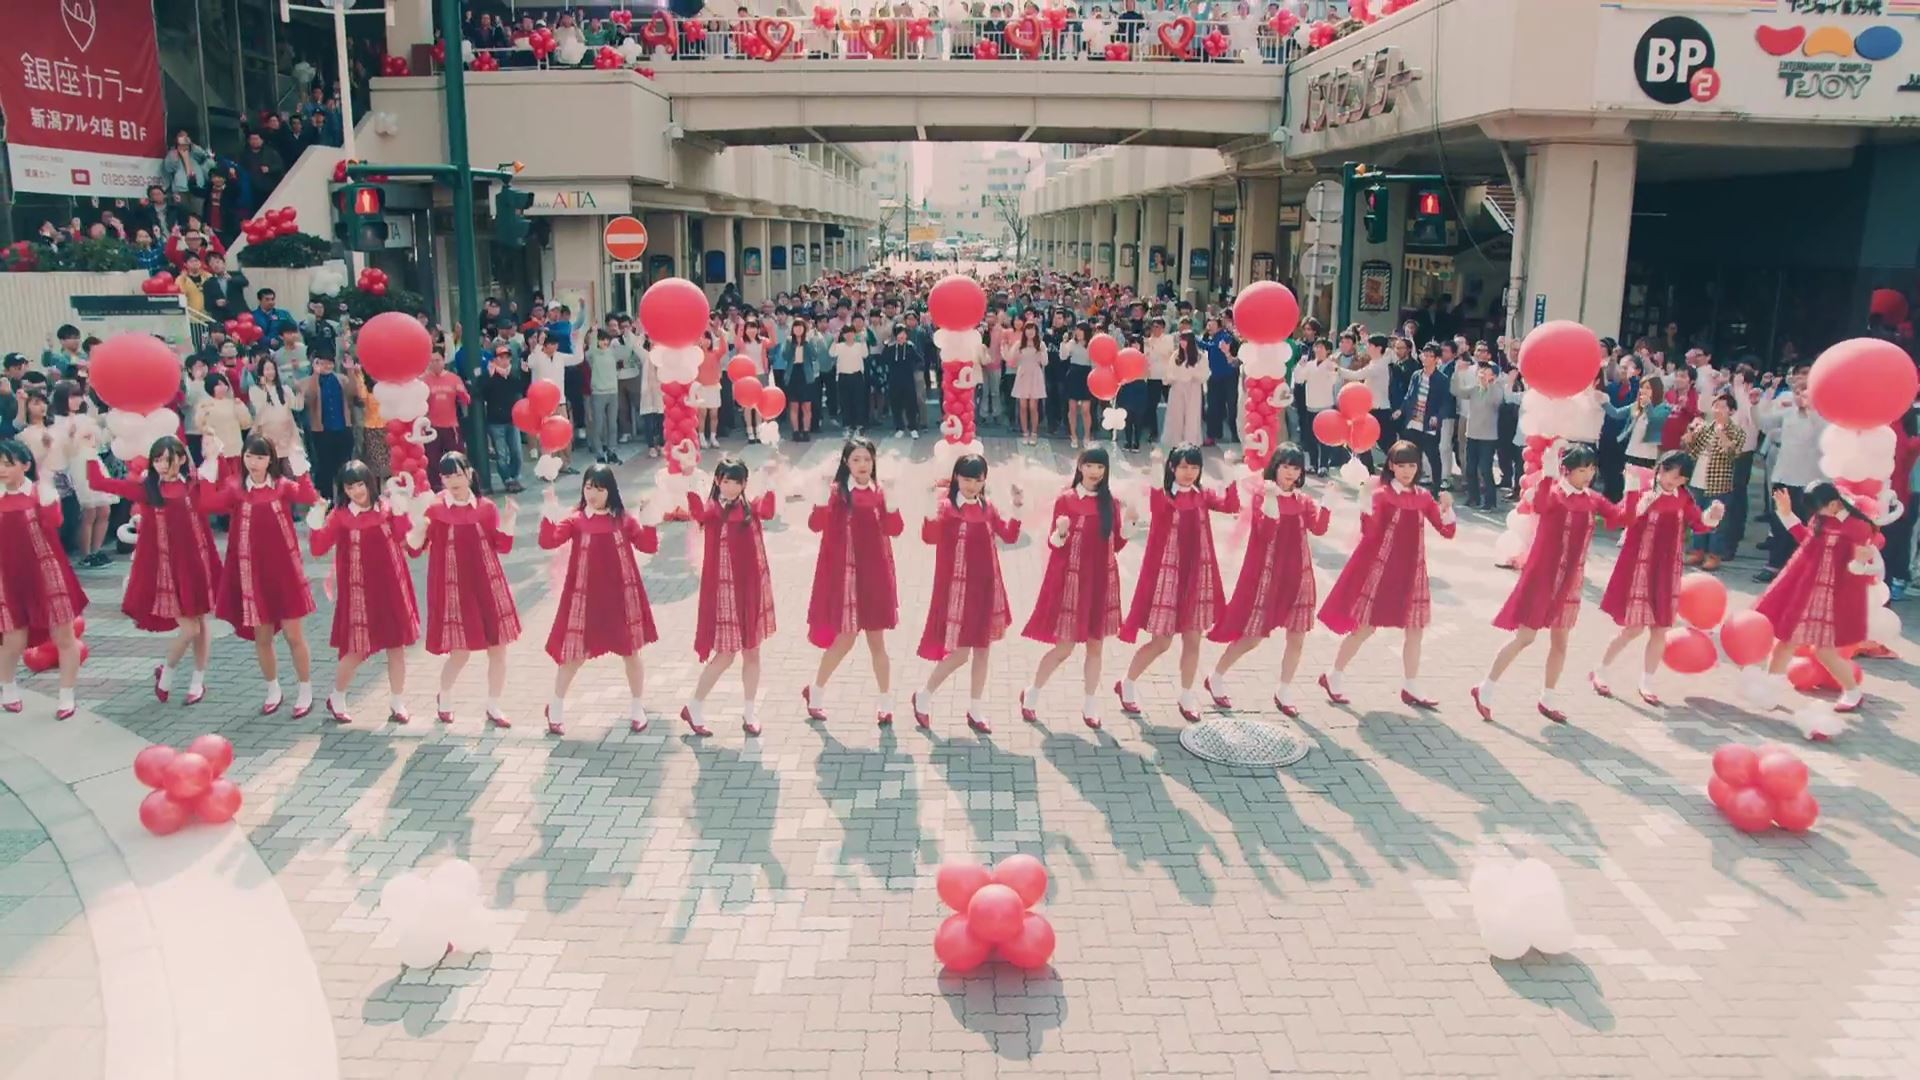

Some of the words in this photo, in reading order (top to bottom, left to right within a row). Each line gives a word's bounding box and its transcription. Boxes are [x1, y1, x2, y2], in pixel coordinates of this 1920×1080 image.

[20, 52, 143, 102] 銀座カラー
[1697, 74, 1713, 96] 2
[30, 107, 114, 138] 新潟アルタ店
[119, 120, 147, 141] B1F
